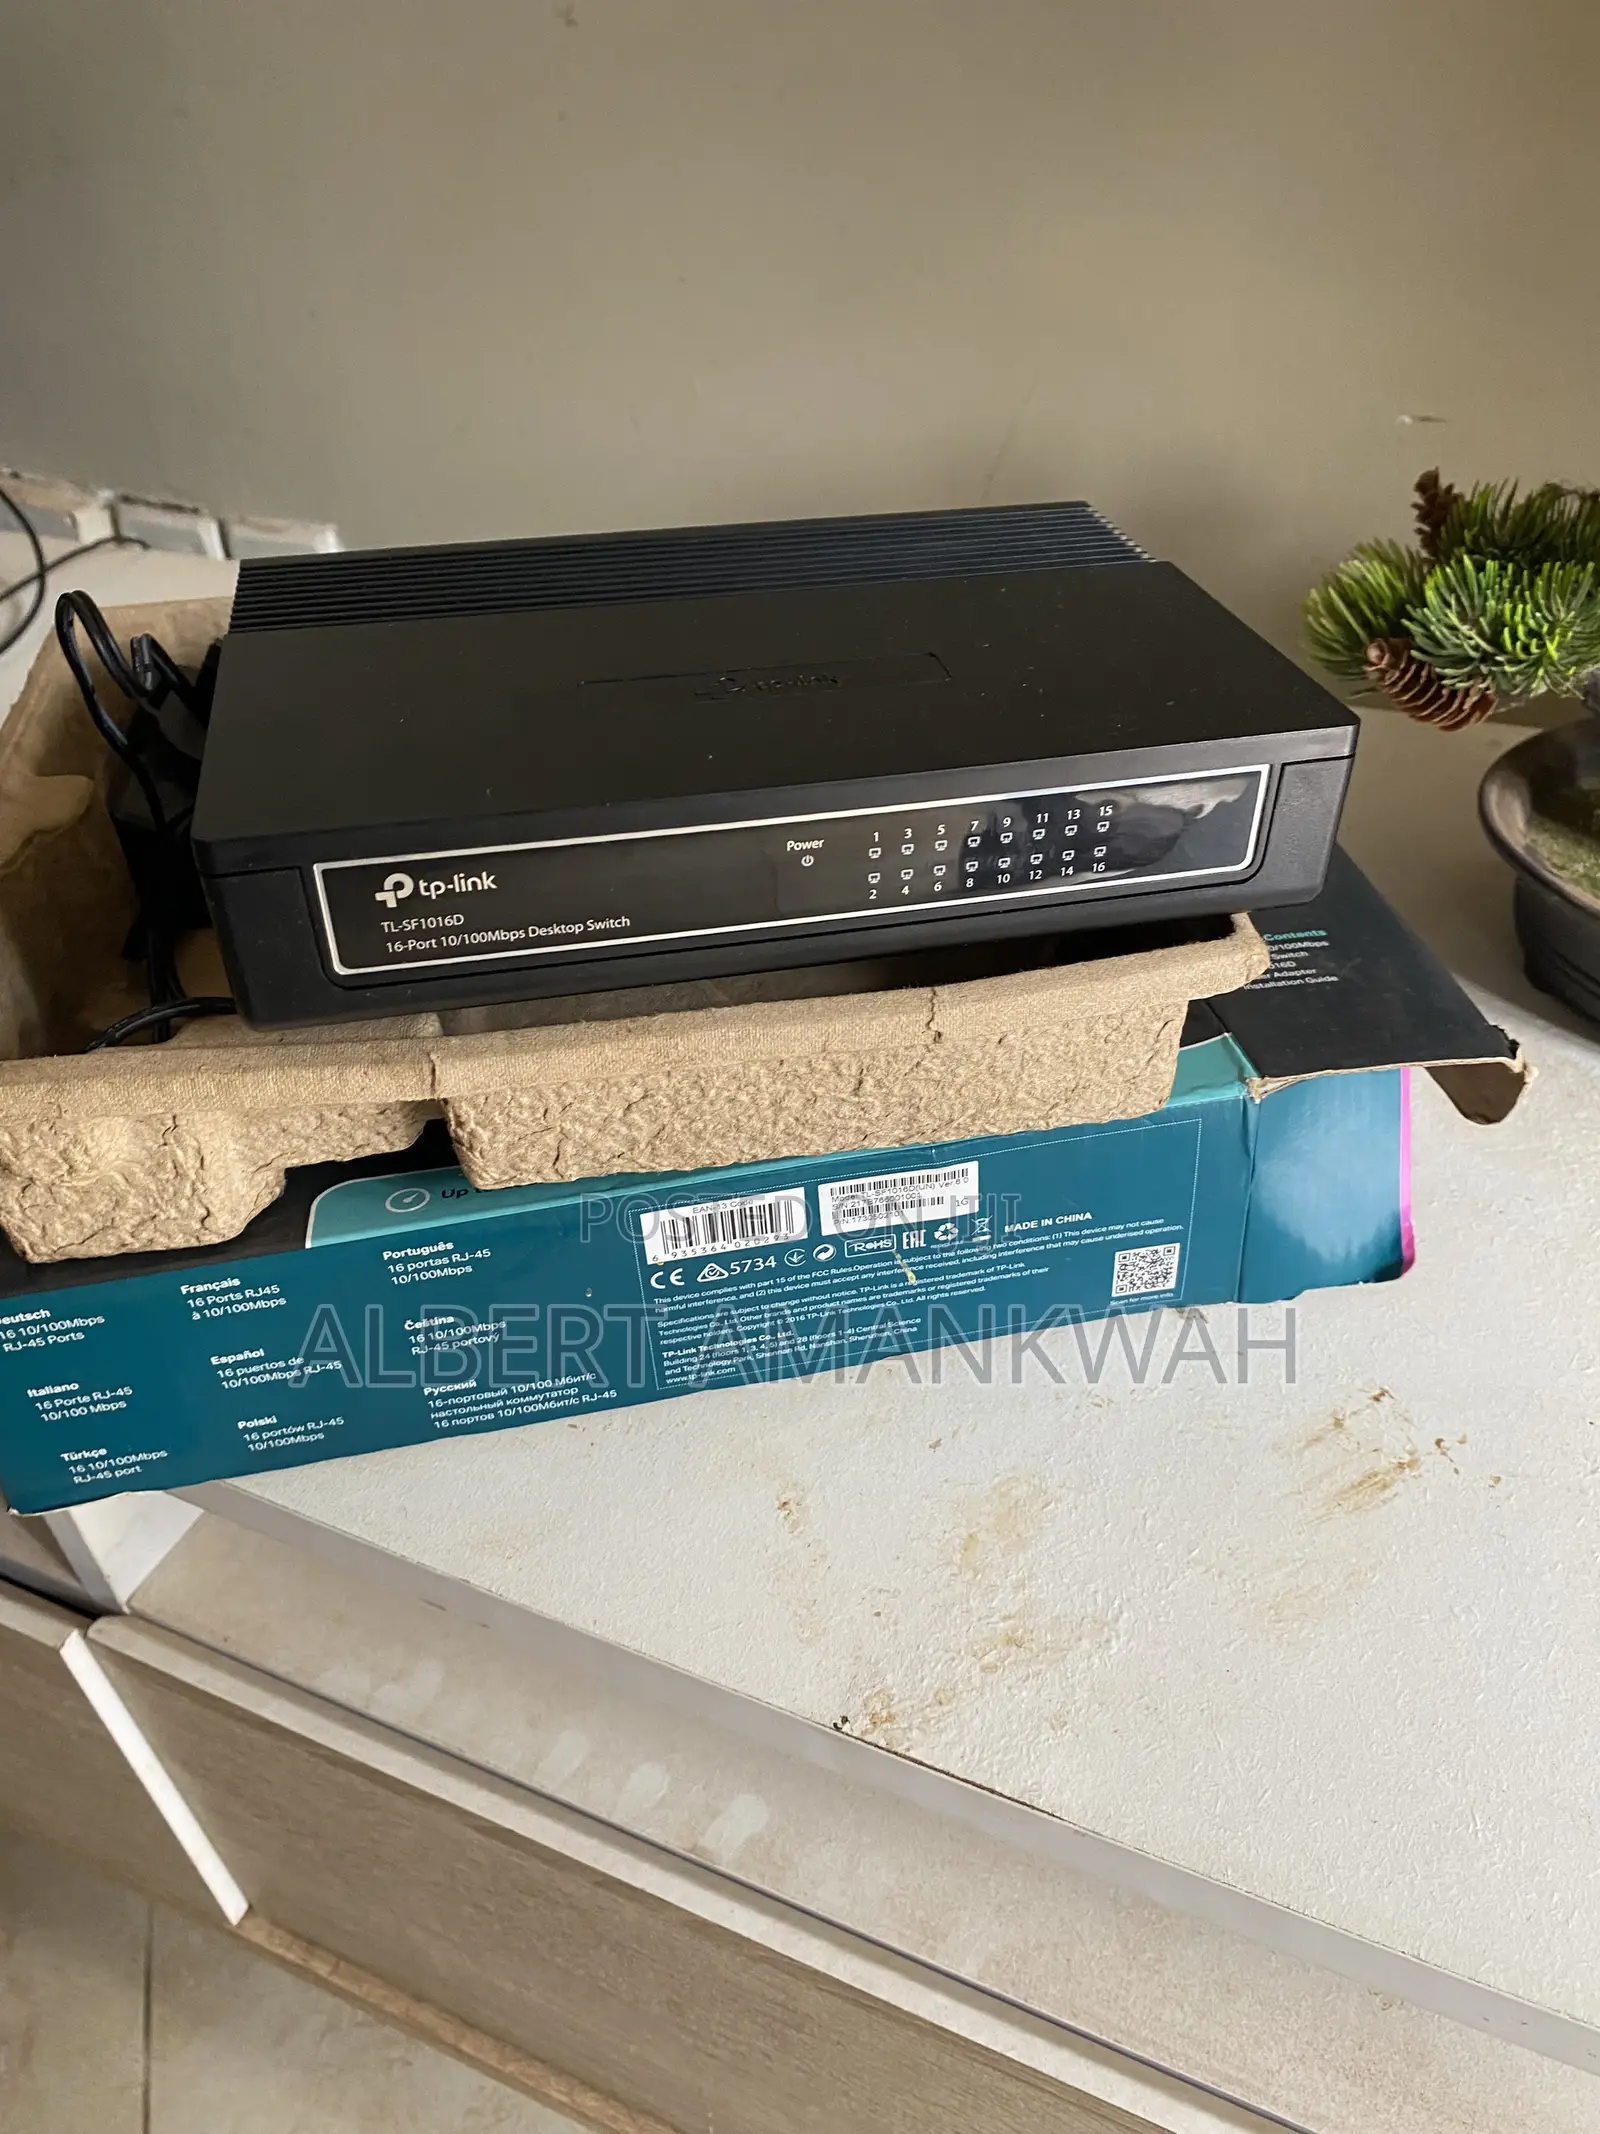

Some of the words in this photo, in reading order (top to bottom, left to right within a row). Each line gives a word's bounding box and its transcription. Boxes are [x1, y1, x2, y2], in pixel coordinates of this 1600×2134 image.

[873, 832, 879, 842] 1
[904, 828, 912, 839] 3
[937, 824, 945, 835] 5
[971, 820, 980, 831] 7
[1003, 817, 1011, 828] 9
[1036, 812, 1049, 824] 11
[1067, 809, 1081, 820] 13
[1099, 805, 1113, 817] 15
[786, 839, 825, 852] Power
[418, 871, 498, 900] tp-link
[869, 889, 877, 899] 2
[901, 886, 910, 895] 4
[934, 881, 943, 892] 6
[966, 877, 974, 888] 8
[997, 873, 1011, 884] 10
[1029, 870, 1043, 880] 12
[1060, 866, 1074, 876] 14
[1092, 862, 1106, 873] 16
[381, 913, 465, 934] TL-SF1016D
[386, 938, 438, 953] 16-Port
[440, 927, 526, 948] 10/100Mbps
[528, 922, 584, 938] Desktop
[586, 915, 631, 931] Switch
[1263, 929, 1329, 941] Contents
[1274, 969, 1317, 978] Adapter
[1305, 976, 1339, 984] Guide
[441, 1188, 469, 1199] Up
[1004, 1220, 1039, 1233] MADE
[1040, 1217, 1053, 1227] IN
[1055, 1211, 1093, 1225] CHINA
[383, 1241, 455, 1261] Português
[387, 1264, 404, 1274] 16
[406, 1255, 450, 1271] portas
[451, 1248, 492, 1263] RJ-45
[654, 1297, 671, 1305] This
[672, 1292, 700, 1302] device
[701, 1286, 738, 1297] complies
[738, 1282, 756, 1290] with
[757, 1279, 774, 1288] part
[811, 1269, 830, 1277] FCC
[992, 1242, 1008, 1250] two
[1063, 1230, 1080, 1238] This
[1081, 1226, 1107, 1236] device
[1107, 1224, 1125, 1232] may
[1140, 1218, 1165, 1226] cause
[391, 1265, 473, 1285] 10/100Mbps
[730, 1256, 777, 1275] 5734
[738, 1291, 755, 1300] and
[755, 1289, 766, 1297] (2)
[783, 1282, 810, 1292] device
[810, 1279, 832, 1287] must
[832, 1274, 860, 1284] accept
[860, 1271, 876, 1280] any
[961, 1252, 997, 1264] including
[998, 1245, 1046, 1257] interference
[1046, 1241, 1062, 1249] that
[1062, 1239, 1080, 1247] may
[1080, 1236, 1104, 1244] cause
[180, 1276, 242, 1295] Français
[187, 1298, 204, 1309] 16
[206, 1291, 244, 1305] Ports
[244, 1284, 281, 1298] RJ45
[0, 1308, 52, 1325] eutsch
[191, 1310, 201, 1321] à
[203, 1297, 287, 1318] 10/100Mbps
[0, 1329, 16, 1341] 16
[19, 1315, 105, 1336] 10/100Mbps
[404, 1315, 455, 1332] Čeština
[409, 1333, 426, 1344] 16
[427, 1320, 508, 1341] 10/100Mbps
[3, 1337, 46, 1353] RJ-45
[48, 1331, 85, 1345] Ports
[411, 1341, 450, 1356] RJ-45
[452, 1332, 500, 1350] portový
[210, 1348, 265, 1366] Español
[216, 1368, 234, 1379] 16
[236, 1360, 286, 1377] puertos
[288, 1355, 305, 1367] de
[221, 1369, 302, 1389] 10/100Mbps
[303, 1360, 343, 1375] RJ-45
[26, 1382, 80, 1398] Italiano
[35, 1401, 52, 1411] 16
[54, 1393, 91, 1408] Porte
[92, 1386, 133, 1401] RJ-45
[423, 1379, 477, 1396] Русский
[428, 1387, 508, 1409] 16-портовый
[510, 1379, 553, 1394] 10/100
[555, 1371, 597, 1387] Мбит/с
[40, 1406, 88, 1422] 10/100
[89, 1400, 127, 1414] Mbps
[430, 1399, 505, 1420] настольный
[506, 1386, 579, 1406] коммутатор
[433, 1419, 449, 1429] 16
[452, 1412, 495, 1427] портов
[497, 1397, 580, 1418] 10/100Мбит/с
[582, 1389, 617, 1403] RJ-45
[237, 1414, 278, 1430] Polski
[243, 1431, 260, 1442] 16
[261, 1423, 306, 1441] portów
[306, 1416, 345, 1431] RJ-45
[247, 1432, 325, 1452] 10/100Mbps
[60, 1447, 108, 1462] Türkçe
[68, 1464, 86, 1474] 16
[88, 1450, 169, 1471] 10/100Mbps
[73, 1470, 113, 1484] RJ-45
[114, 1465, 143, 1478] port
